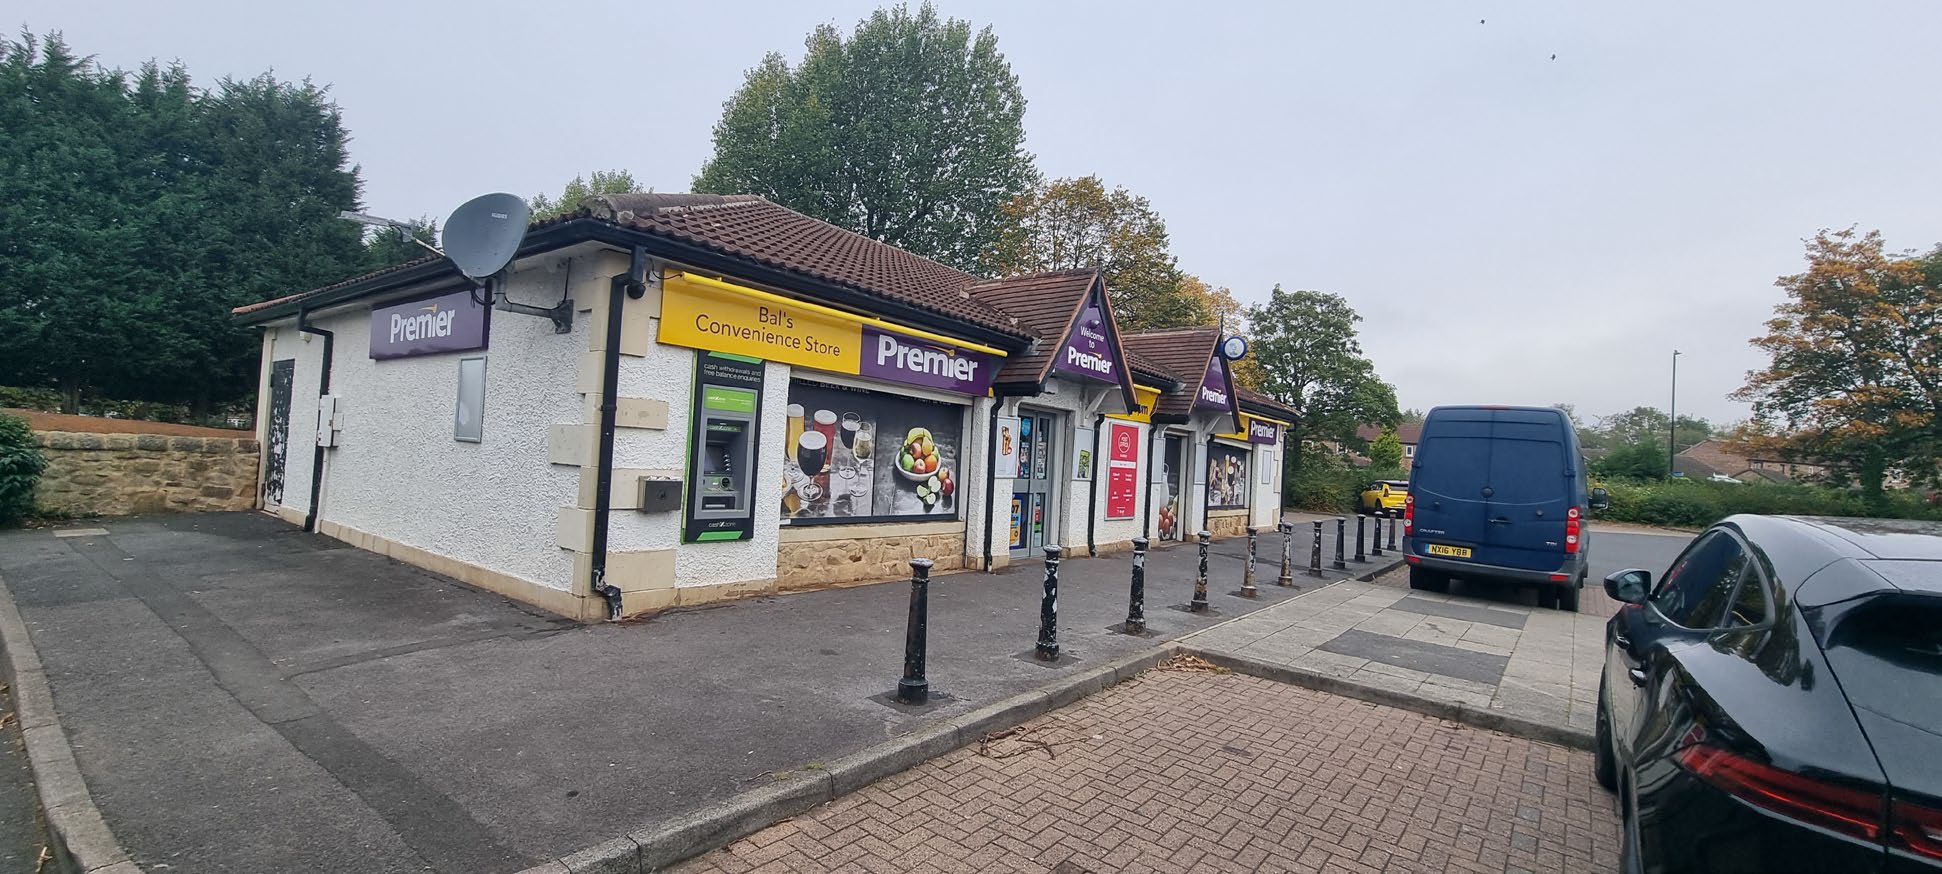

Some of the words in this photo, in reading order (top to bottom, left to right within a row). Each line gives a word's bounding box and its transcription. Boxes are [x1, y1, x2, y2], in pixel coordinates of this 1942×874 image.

[389, 309, 456, 344] Premier
[758, 306, 794, 329] Bal's
[695, 313, 801, 349] Convenience
[805, 335, 841, 357] Store
[1080, 325, 1105, 343] Welcome
[1088, 339, 1096, 350] to
[877, 334, 978, 382] Premier
[1067, 345, 1113, 375] Premier
[1201, 386, 1227, 405] Premier
[1250, 420, 1276, 439] Premier
[1431, 545, 1449, 554] NX16
